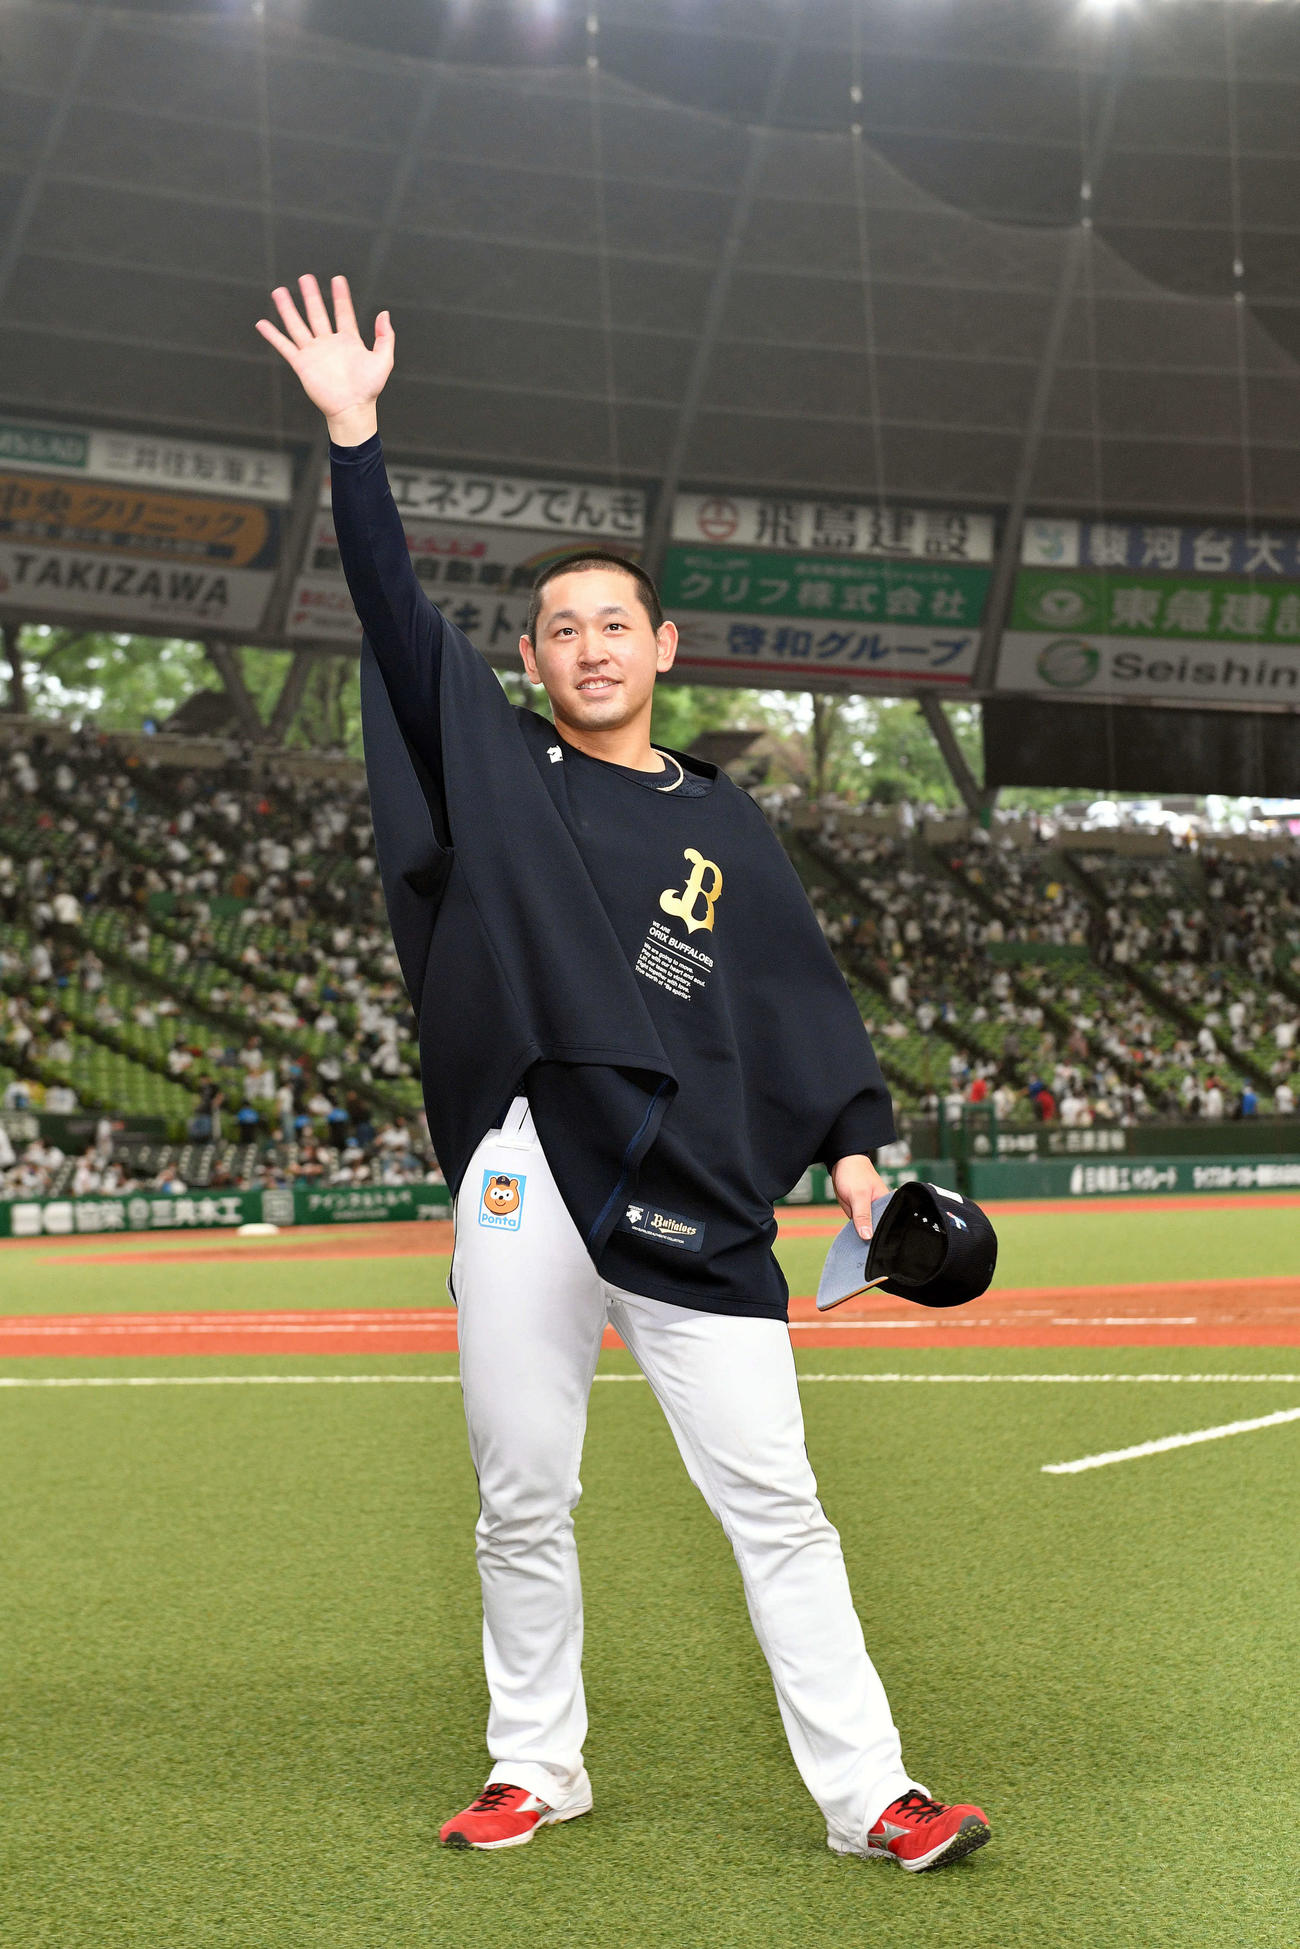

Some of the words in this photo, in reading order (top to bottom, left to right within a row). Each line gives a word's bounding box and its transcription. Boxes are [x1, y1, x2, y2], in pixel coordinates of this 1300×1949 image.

[392, 475, 643, 530] エネワンでんき
[756, 502, 969, 557] 飛島建設
[1090, 524, 1300, 573] 駿河台大
[13, 554, 229, 605] TAKIZAWA
[680, 573, 965, 619] クリフ株式会社
[727, 624, 971, 668] 啓和グループ
[1112, 652, 1297, 688] Seishin
[649, 927, 669, 943] ORIX
[668, 937, 714, 968] BUFFALOES
[482, 1213, 517, 1227] Ponta
[650, 1213, 697, 1235] Buffaloes
